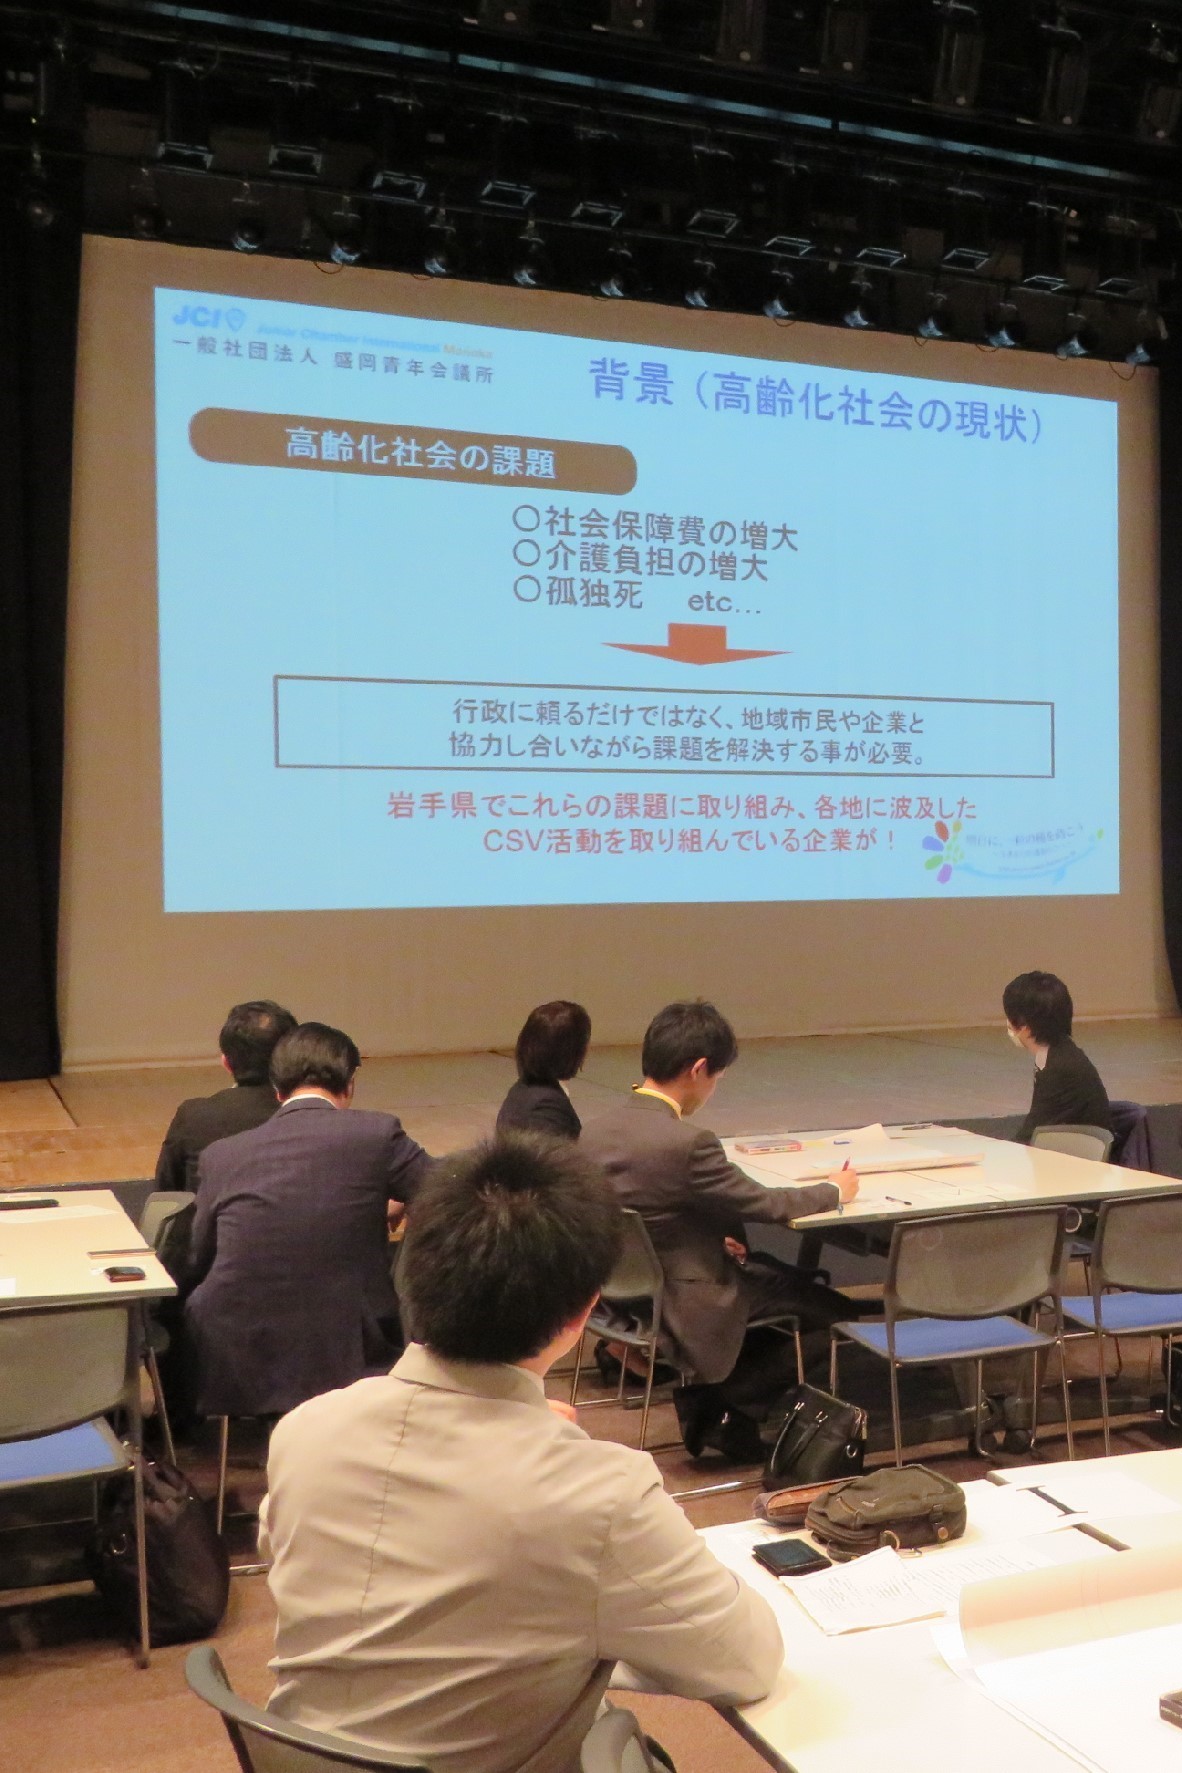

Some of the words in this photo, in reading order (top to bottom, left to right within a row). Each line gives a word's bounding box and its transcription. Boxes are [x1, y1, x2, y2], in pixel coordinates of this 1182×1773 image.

[172, 304, 222, 329] JCI
[173, 335, 318, 365] 一般社団法人
[333, 351, 494, 384] 盛岡青年会議所
[285, 425, 557, 480] 高齢化社会の課題
[452, 698, 924, 735] 行政に頼るだけではなく、地域市民や企業と
[448, 730, 923, 766] 協力し合いながら課題を解決する事が必要。
[387, 791, 977, 820] 岩手県でこれらの課題に取り組み、各地に波及した
